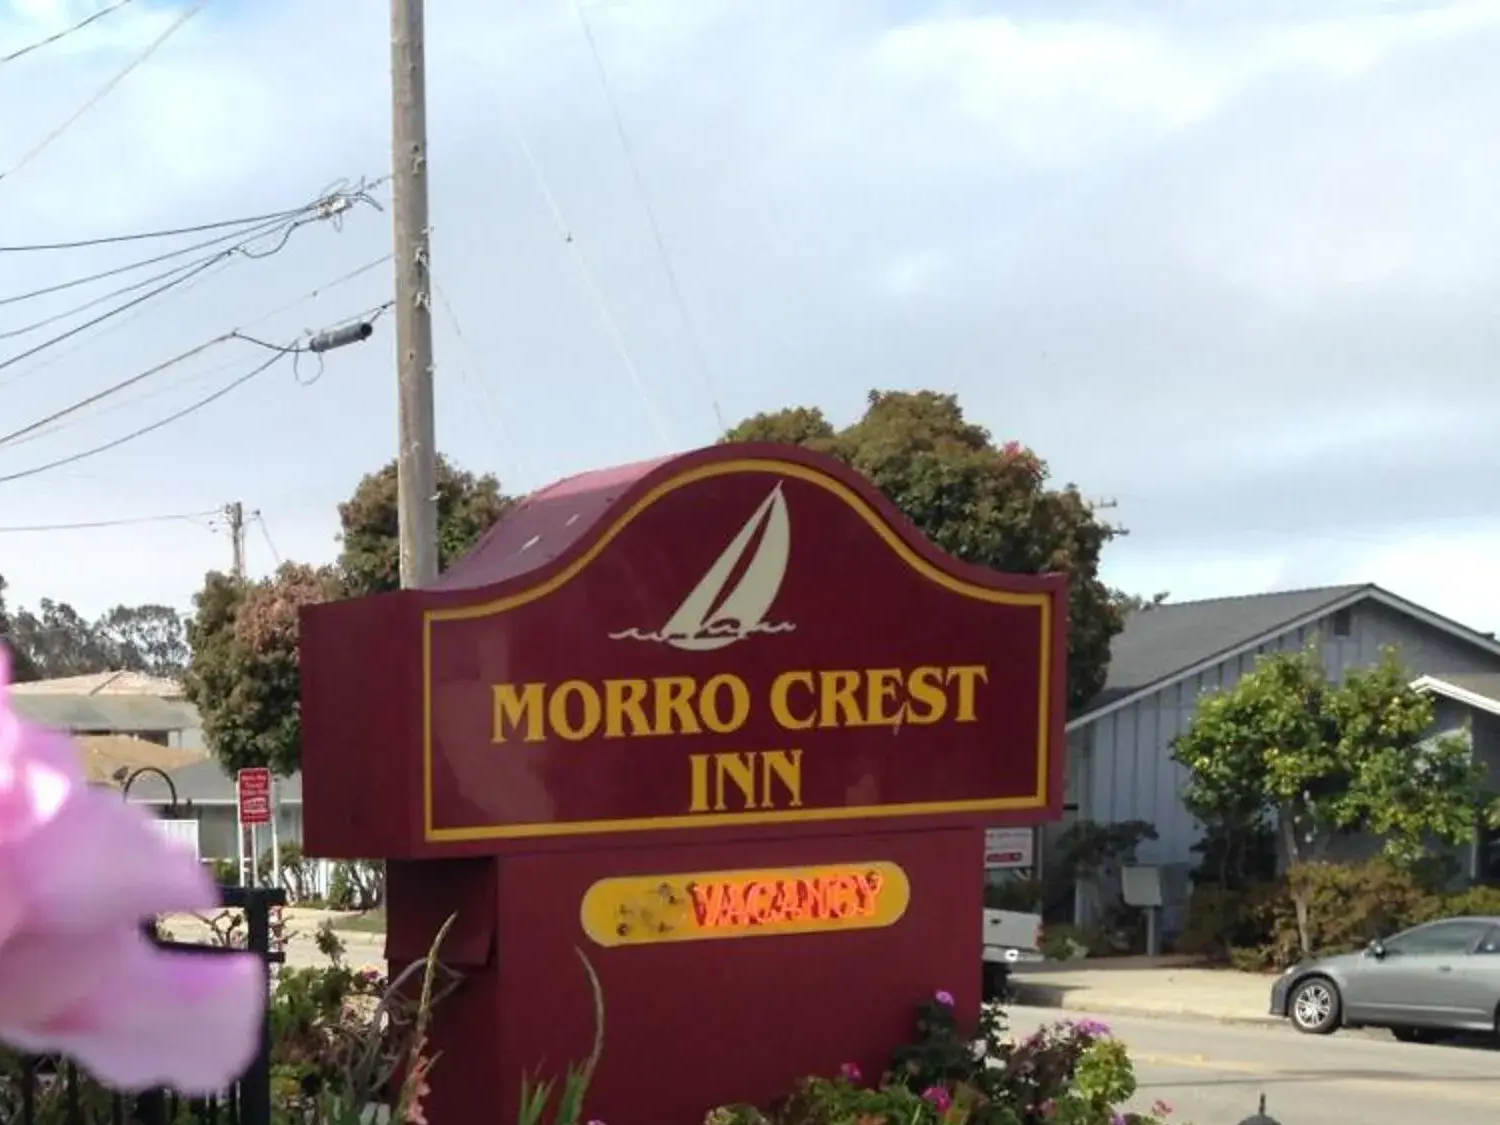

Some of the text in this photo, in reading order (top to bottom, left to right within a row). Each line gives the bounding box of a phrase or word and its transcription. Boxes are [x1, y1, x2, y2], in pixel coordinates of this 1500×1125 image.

[492, 665, 987, 743] MORRO CREST
[689, 750, 804, 812] INN
[687, 871, 883, 927] VACANCY
